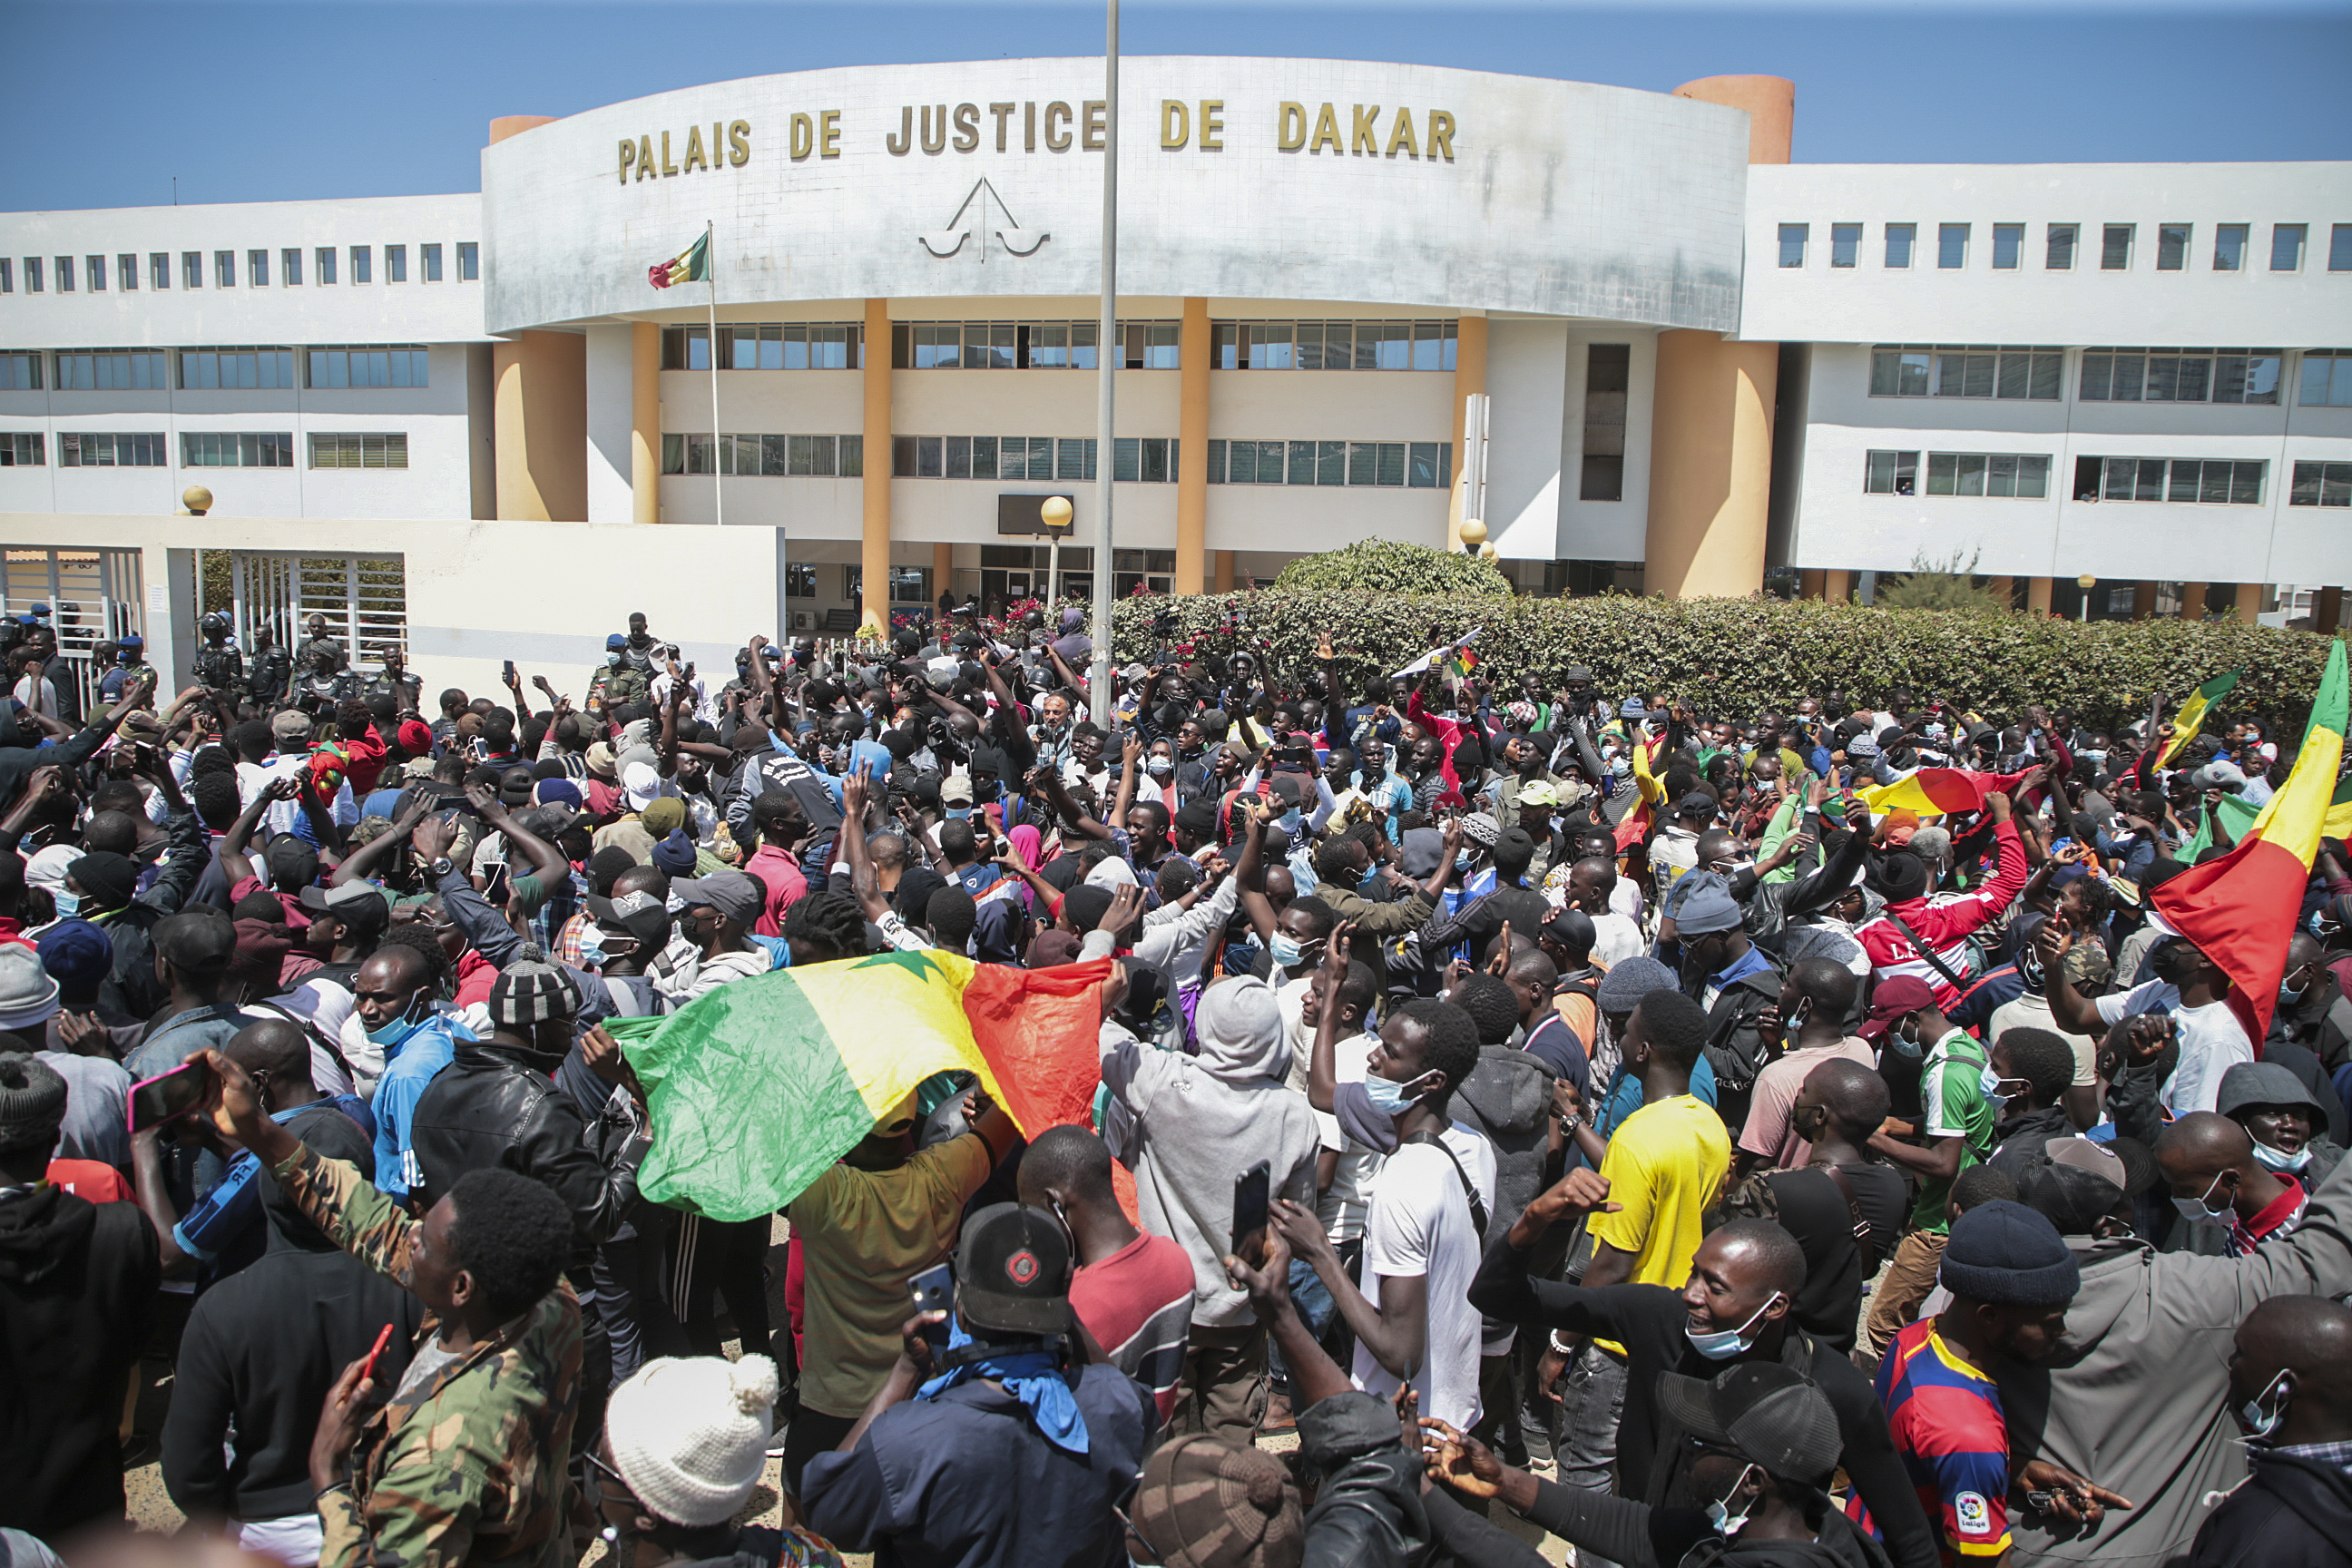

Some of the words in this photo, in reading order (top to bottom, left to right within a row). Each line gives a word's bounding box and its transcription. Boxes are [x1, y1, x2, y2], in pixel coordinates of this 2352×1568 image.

[619, 119, 750, 183] PALAIS
[790, 110, 841, 159] DE
[886, 100, 1106, 153] JUSTICE
[1161, 99, 1224, 148] DE
[1278, 101, 1456, 159] DAKAR
[1714, 1073, 1755, 1092] adid
